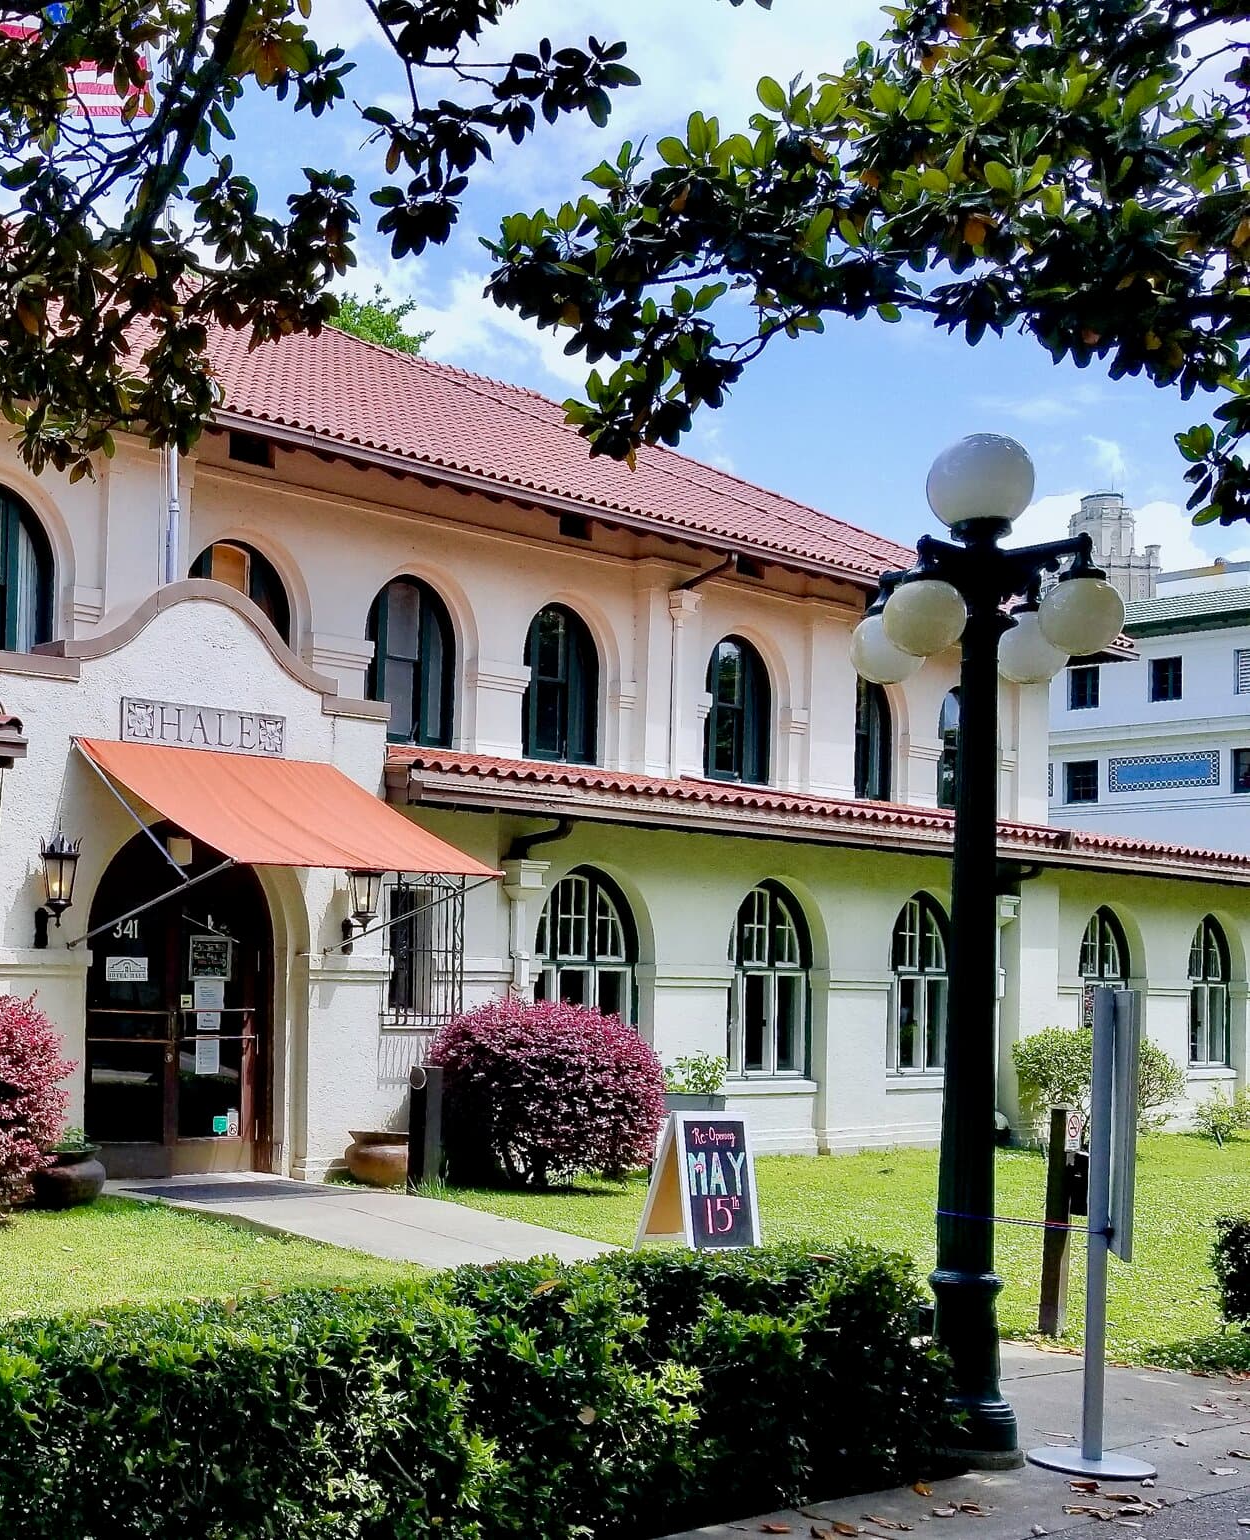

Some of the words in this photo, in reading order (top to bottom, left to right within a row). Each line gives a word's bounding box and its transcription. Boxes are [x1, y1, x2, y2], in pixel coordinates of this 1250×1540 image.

[157, 706, 256, 750] HALE
[113, 919, 139, 939] 341
[692, 1126, 736, 1147] Re-Opening
[687, 1152, 745, 1196] MAY
[706, 1196, 740, 1234] 15th
